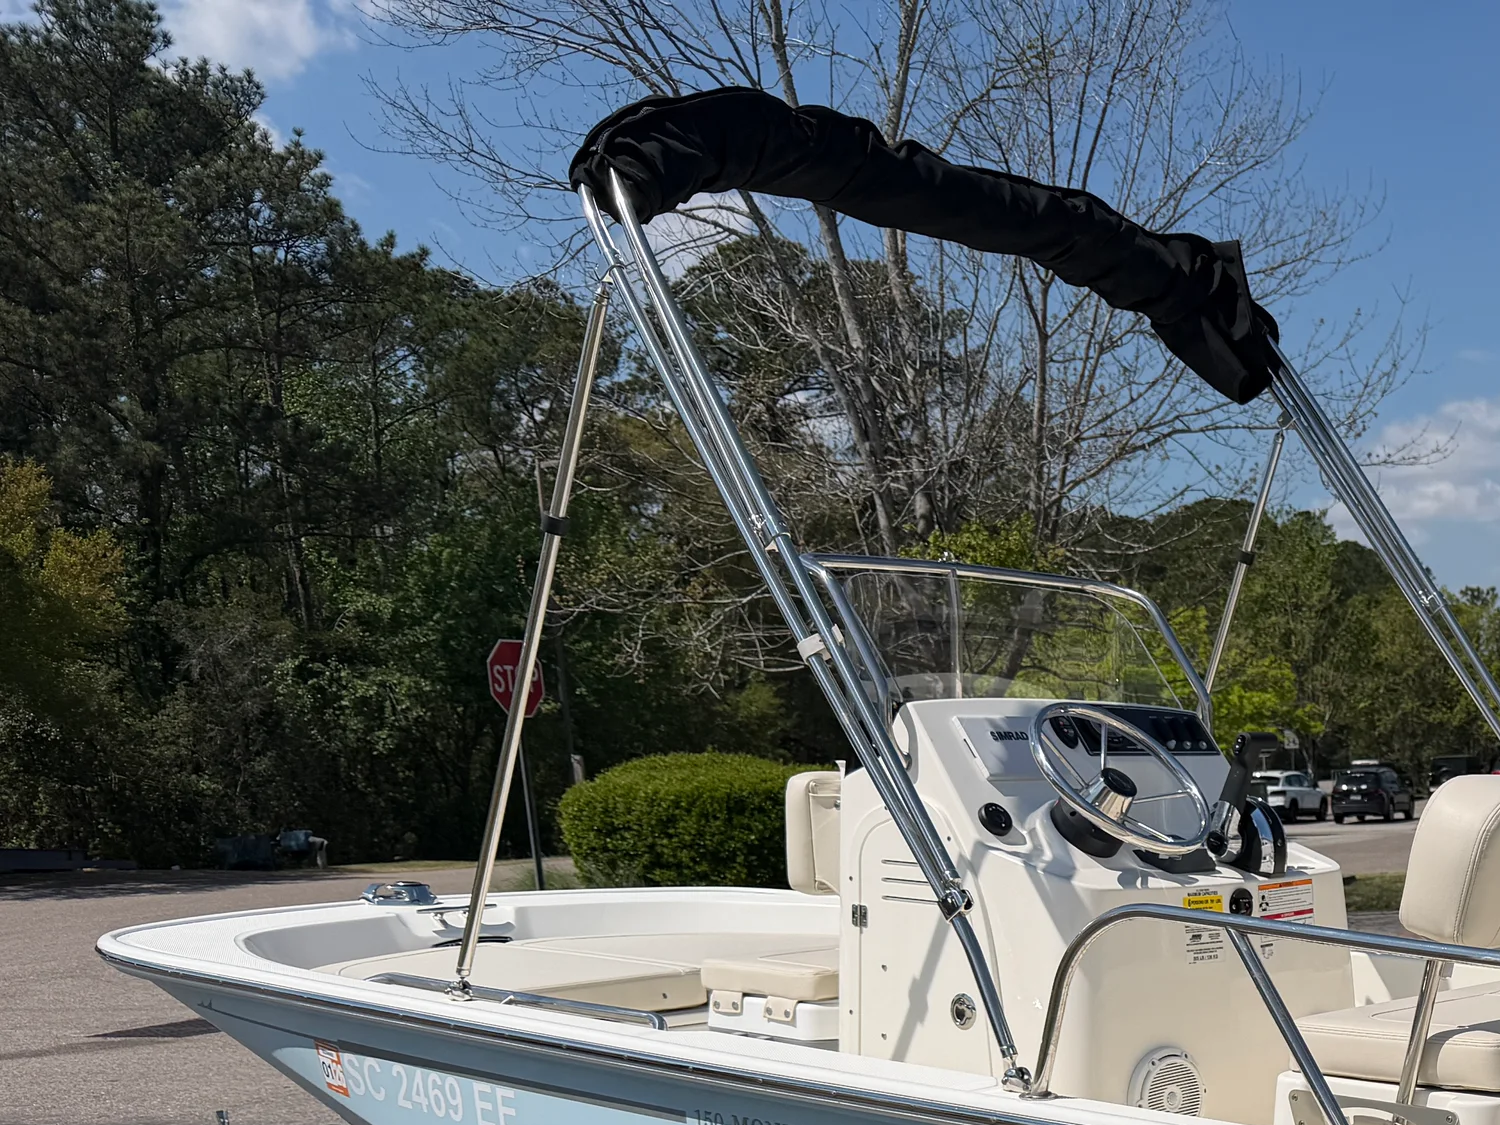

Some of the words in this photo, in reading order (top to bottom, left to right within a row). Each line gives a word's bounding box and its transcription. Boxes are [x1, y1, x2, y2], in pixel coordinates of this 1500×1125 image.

[493, 665, 539, 693] STP
[990, 731, 1030, 742] SIMRAD
[344, 1053, 386, 1101] SC
[392, 1064, 464, 1122] 2469
